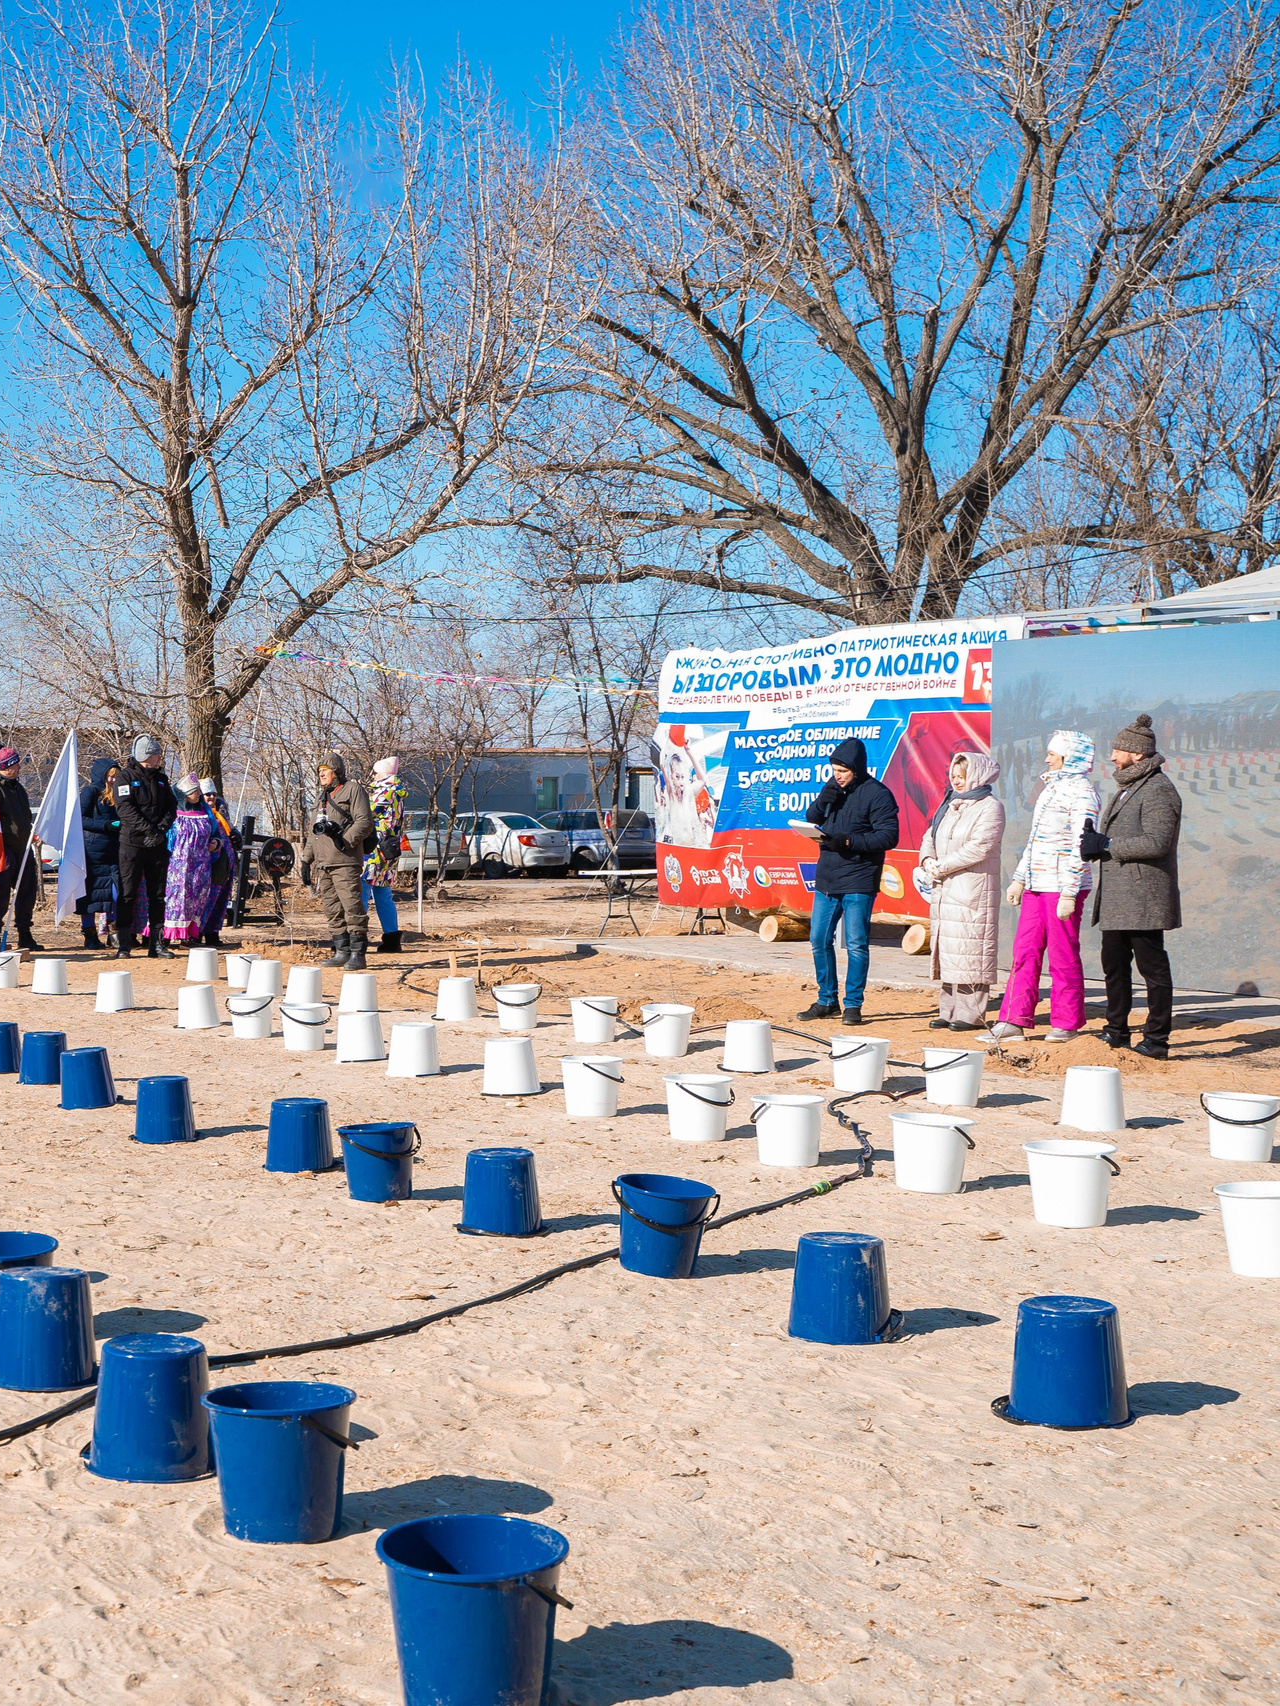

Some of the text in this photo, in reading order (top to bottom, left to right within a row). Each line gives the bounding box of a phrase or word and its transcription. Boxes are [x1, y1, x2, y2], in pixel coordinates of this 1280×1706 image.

[961, 630, 1007, 645] АКЦИЯ
[694, 664, 821, 692] ЗДОРОВЫМ
[831, 656, 871, 680] ЭТО
[875, 651, 959, 677] МОДНО
[745, 691, 792, 704] ПОБЕДЫ
[796, 689, 803, 699] В
[844, 677, 921, 692] ОТЕЧЕСТВЕННОЙ
[923, 677, 957, 689] ВОЙНЕ
[805, 726, 881, 742] ОБЛИВАНИЕ
